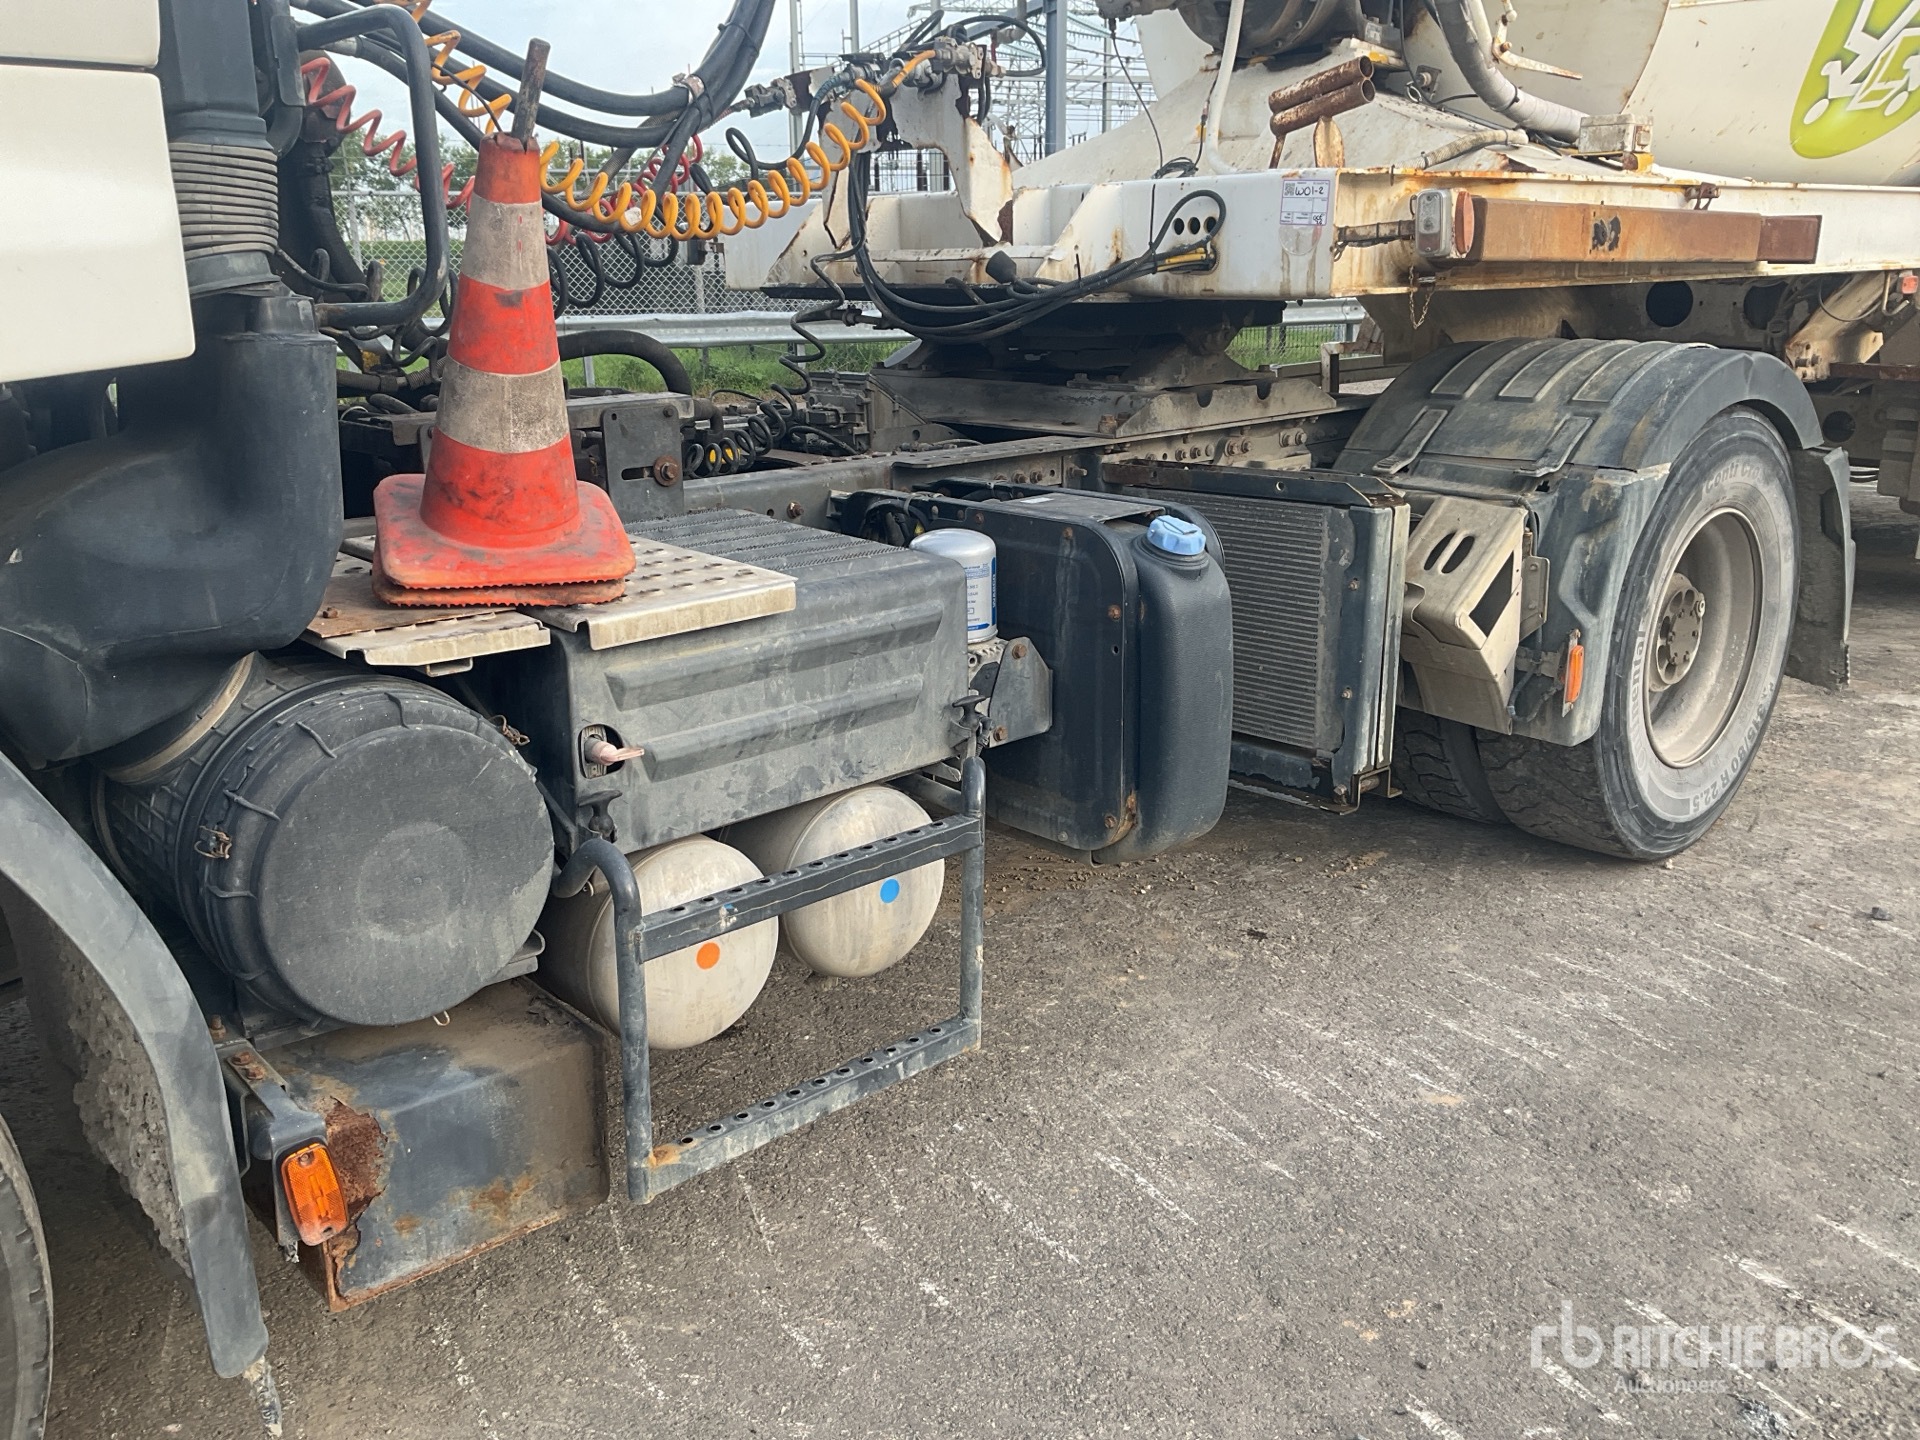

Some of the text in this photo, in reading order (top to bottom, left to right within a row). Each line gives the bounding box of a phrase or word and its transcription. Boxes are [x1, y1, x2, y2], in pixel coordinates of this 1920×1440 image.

[1706, 460, 1739, 494] Conti
[1732, 702, 1768, 774] 315/80
[1720, 771, 1731, 786] R
[1692, 783, 1719, 813] 22.5
